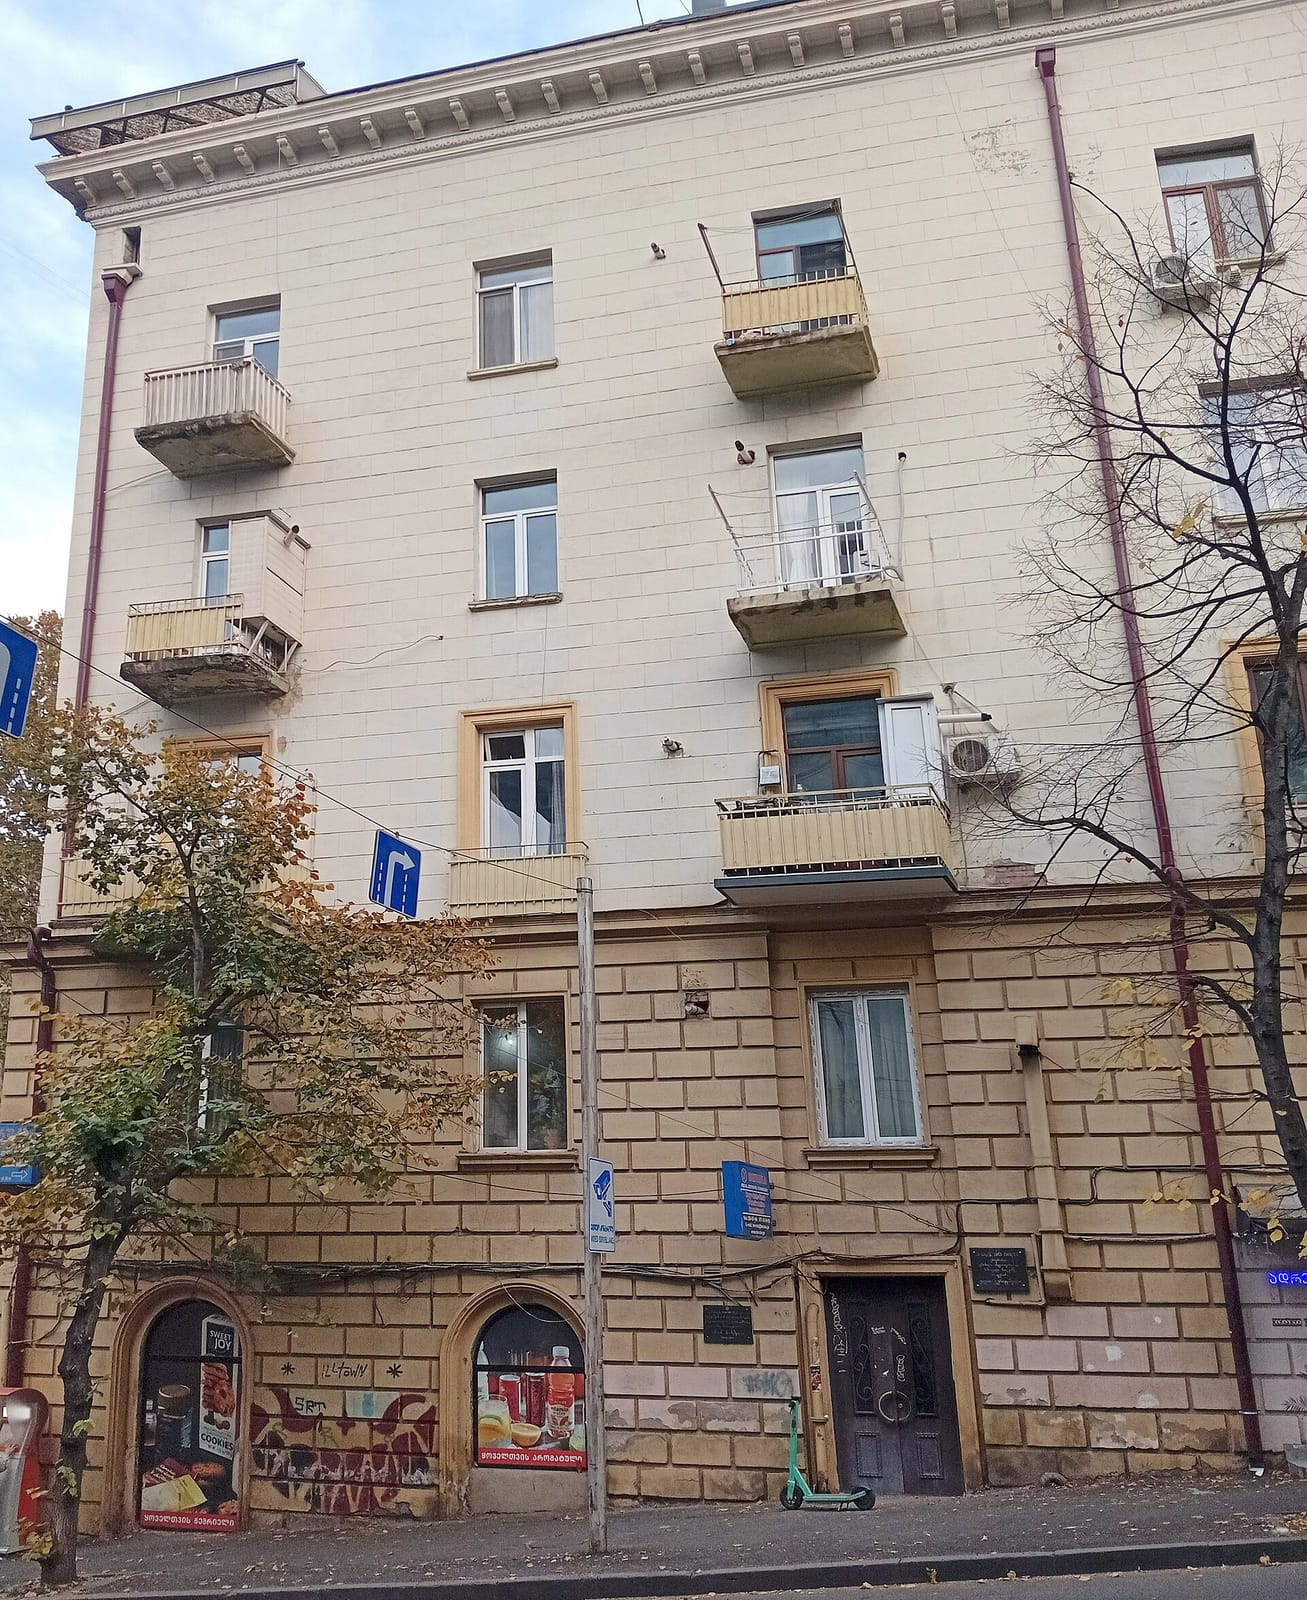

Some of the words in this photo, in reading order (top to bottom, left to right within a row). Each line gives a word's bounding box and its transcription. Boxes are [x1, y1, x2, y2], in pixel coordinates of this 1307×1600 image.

[209, 1329, 232, 1342] SWEET
[214, 1337, 232, 1351] JOY
[201, 1433, 234, 1451] COOKIES
[481, 1451, 530, 1462] ყოველთვის
[144, 1514, 191, 1525] ყოველთვის
